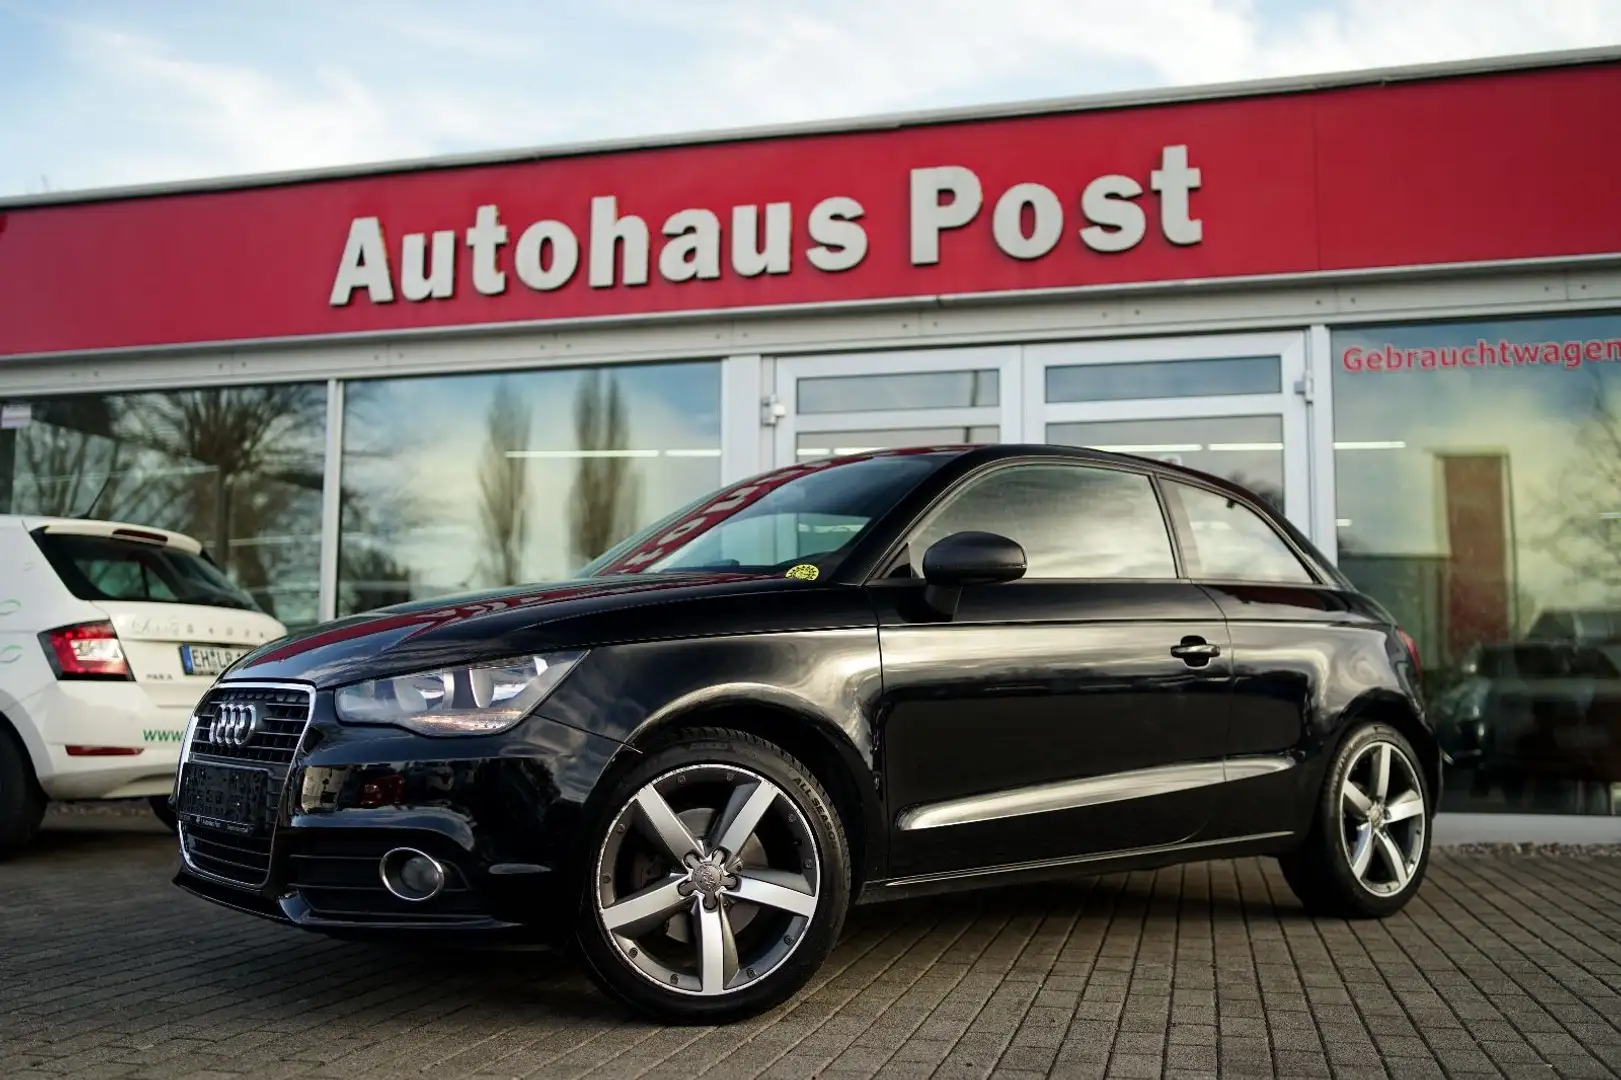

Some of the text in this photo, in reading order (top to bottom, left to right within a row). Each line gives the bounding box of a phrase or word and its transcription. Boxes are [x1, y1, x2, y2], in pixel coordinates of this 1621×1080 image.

[329, 145, 1203, 306] Autohaus Post
[1342, 339, 1621, 372] Gebrauchtwagen
[192, 649, 211, 668] EH
[791, 777, 812, 798] ALL
